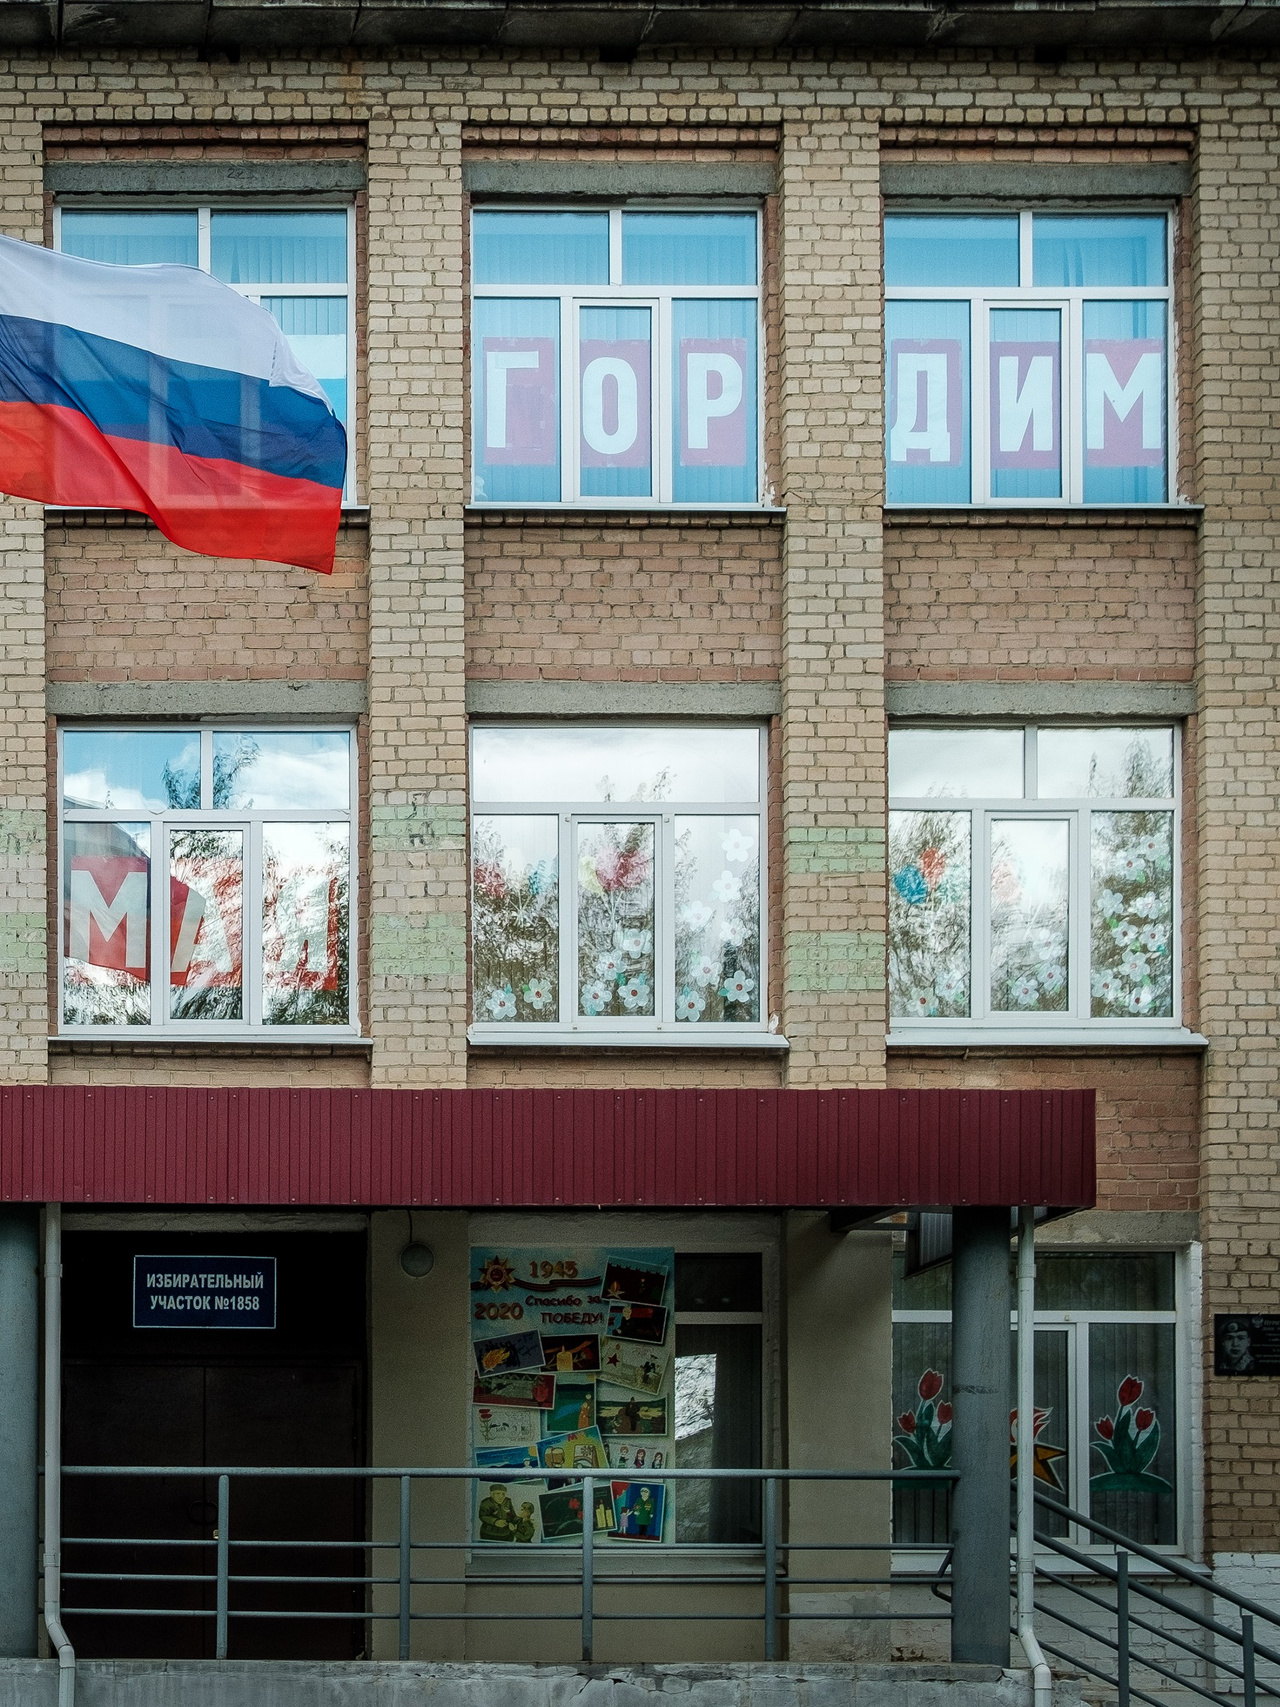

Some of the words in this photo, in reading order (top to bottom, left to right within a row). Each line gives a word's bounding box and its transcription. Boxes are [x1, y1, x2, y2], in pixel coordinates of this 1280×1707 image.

[529, 1260, 578, 1278] 1945
[146, 1271, 264, 1289] ИЗБИРАТЕЛЬНЫЙ
[150, 1295, 211, 1310] УЧАСТОК
[214, 1296, 260, 1310] №1858
[525, 1295, 581, 1307] Спасибо
[587, 1295, 601, 1304] за
[474, 1302, 523, 1320] 2020
[541, 1312, 604, 1325] ПОБЕДУ!
